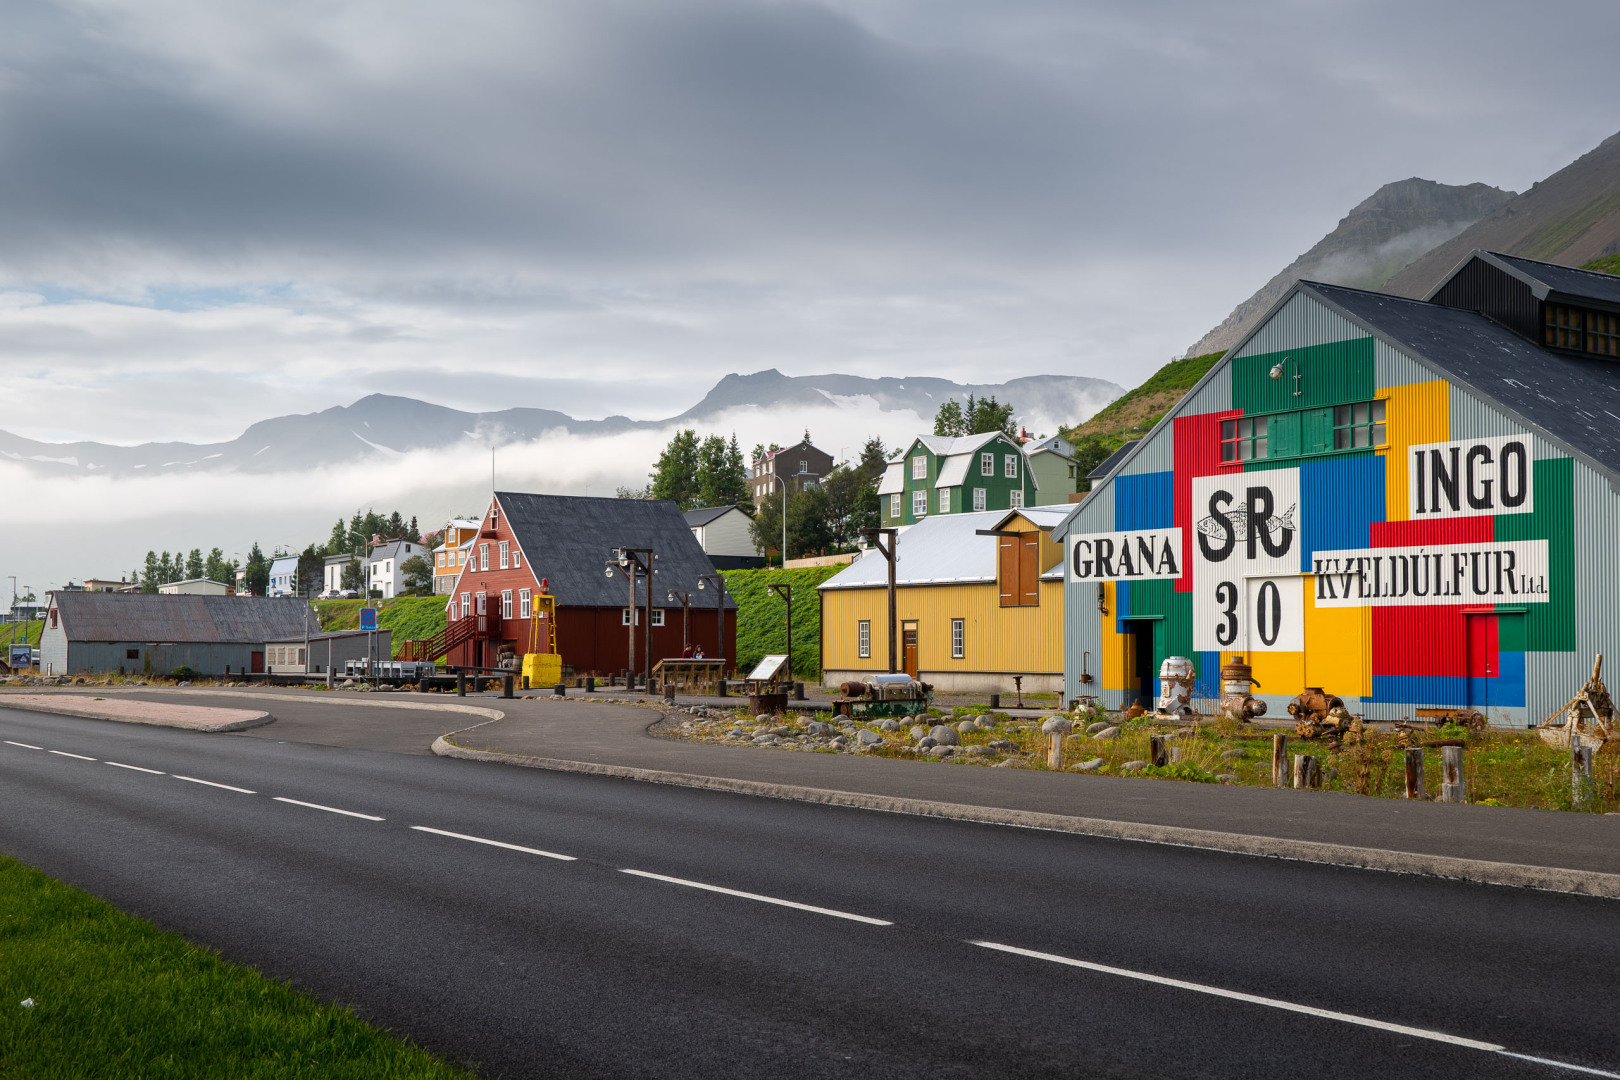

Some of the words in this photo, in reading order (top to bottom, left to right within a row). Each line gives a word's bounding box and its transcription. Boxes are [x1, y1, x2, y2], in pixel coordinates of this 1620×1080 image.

[1415, 441, 1527, 514] INGO
[1198, 486, 1293, 563] SR
[1073, 534, 1180, 578] GRÁNA
[1313, 549, 1519, 599] KVELDÚLFUR
[1521, 574, 1548, 594] Ltd.
